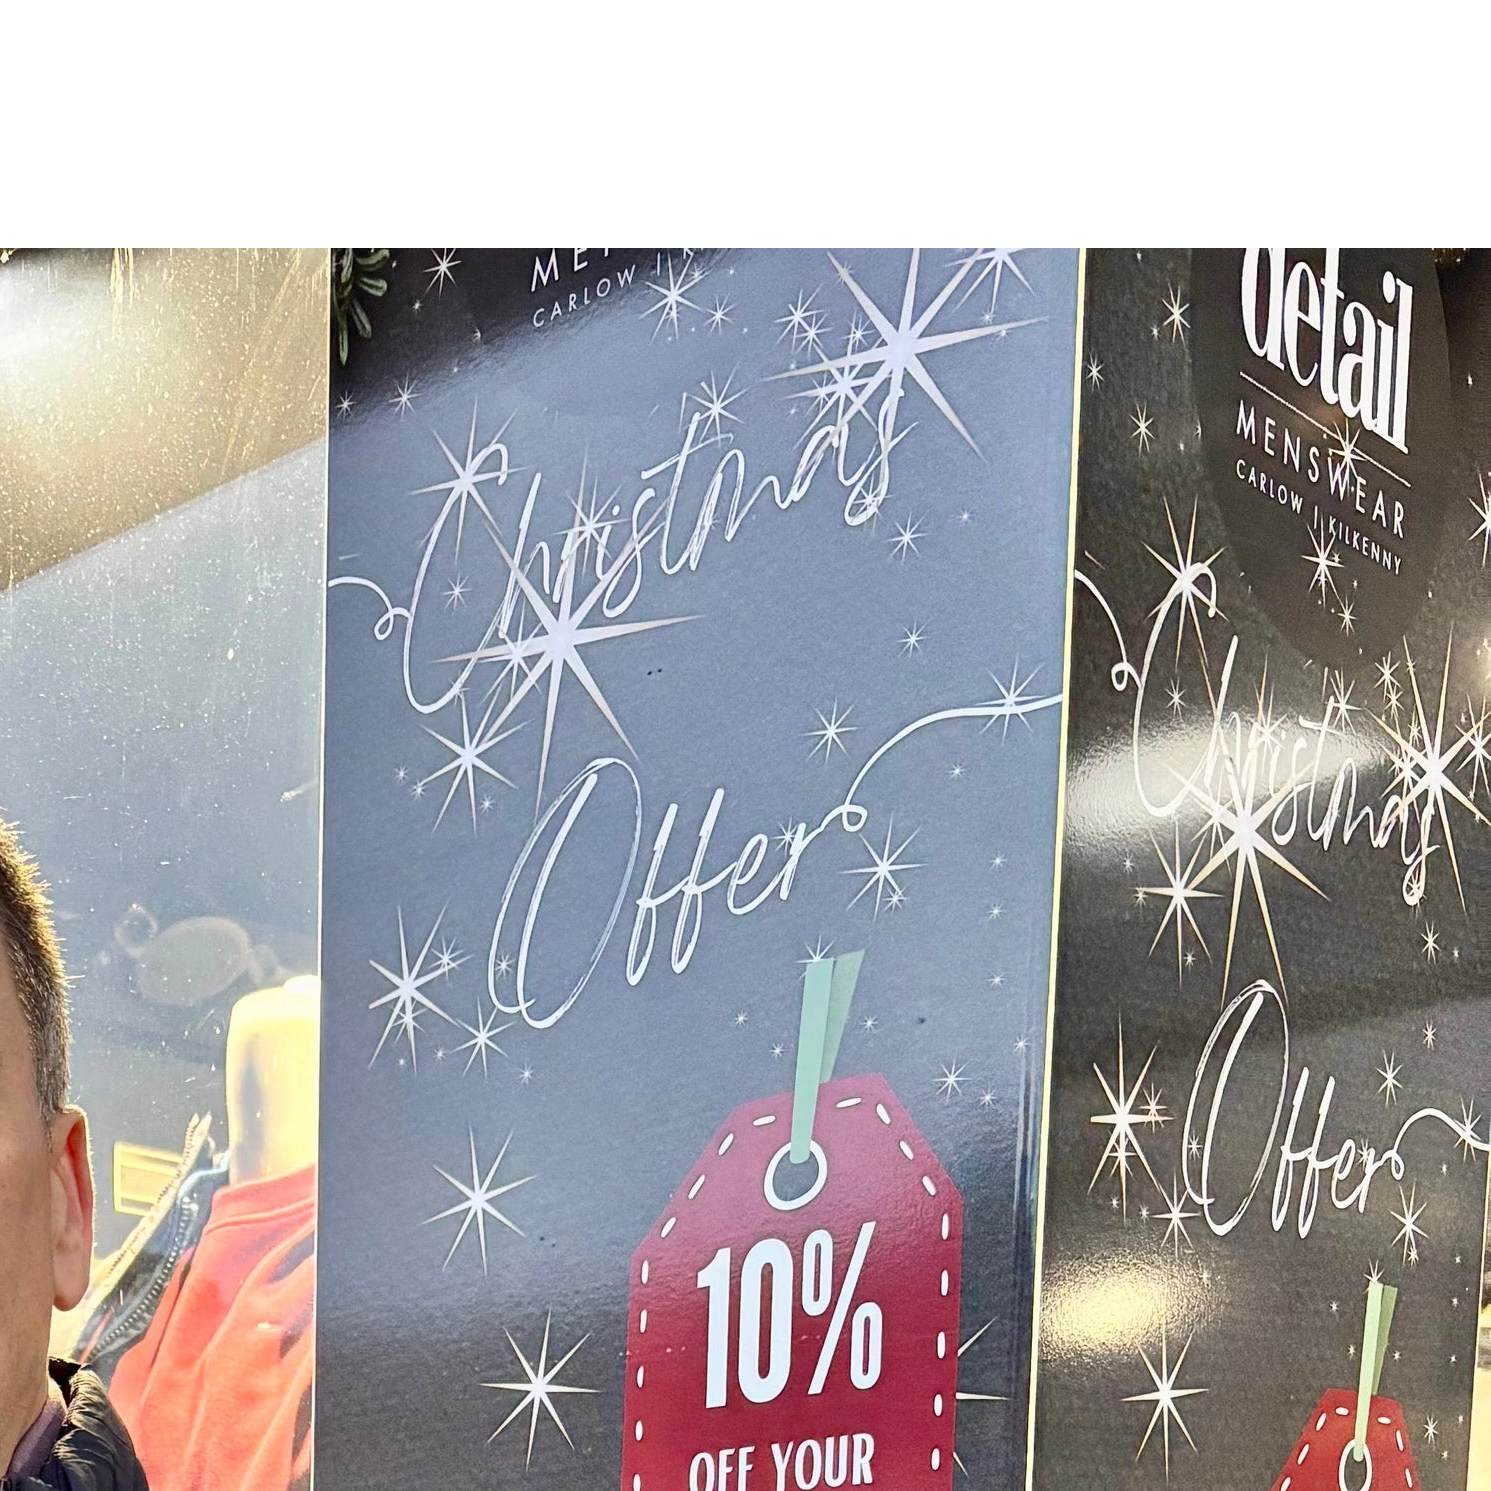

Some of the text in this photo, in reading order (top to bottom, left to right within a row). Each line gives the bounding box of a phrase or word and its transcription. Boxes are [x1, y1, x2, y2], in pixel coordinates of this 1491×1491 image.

[533, 264, 636, 327] CARLOW
[1241, 248, 1413, 455] detail
[400, 391, 918, 713] Christmas
[1236, 400, 1405, 538] MENSWEAR
[1236, 459, 1402, 575] CARLOW KILKENNY
[1132, 562, 1442, 907] Christmas
[487, 758, 868, 1028] Offer
[1181, 978, 1405, 1238] Offer
[697, 1221, 883, 1410] 10%
